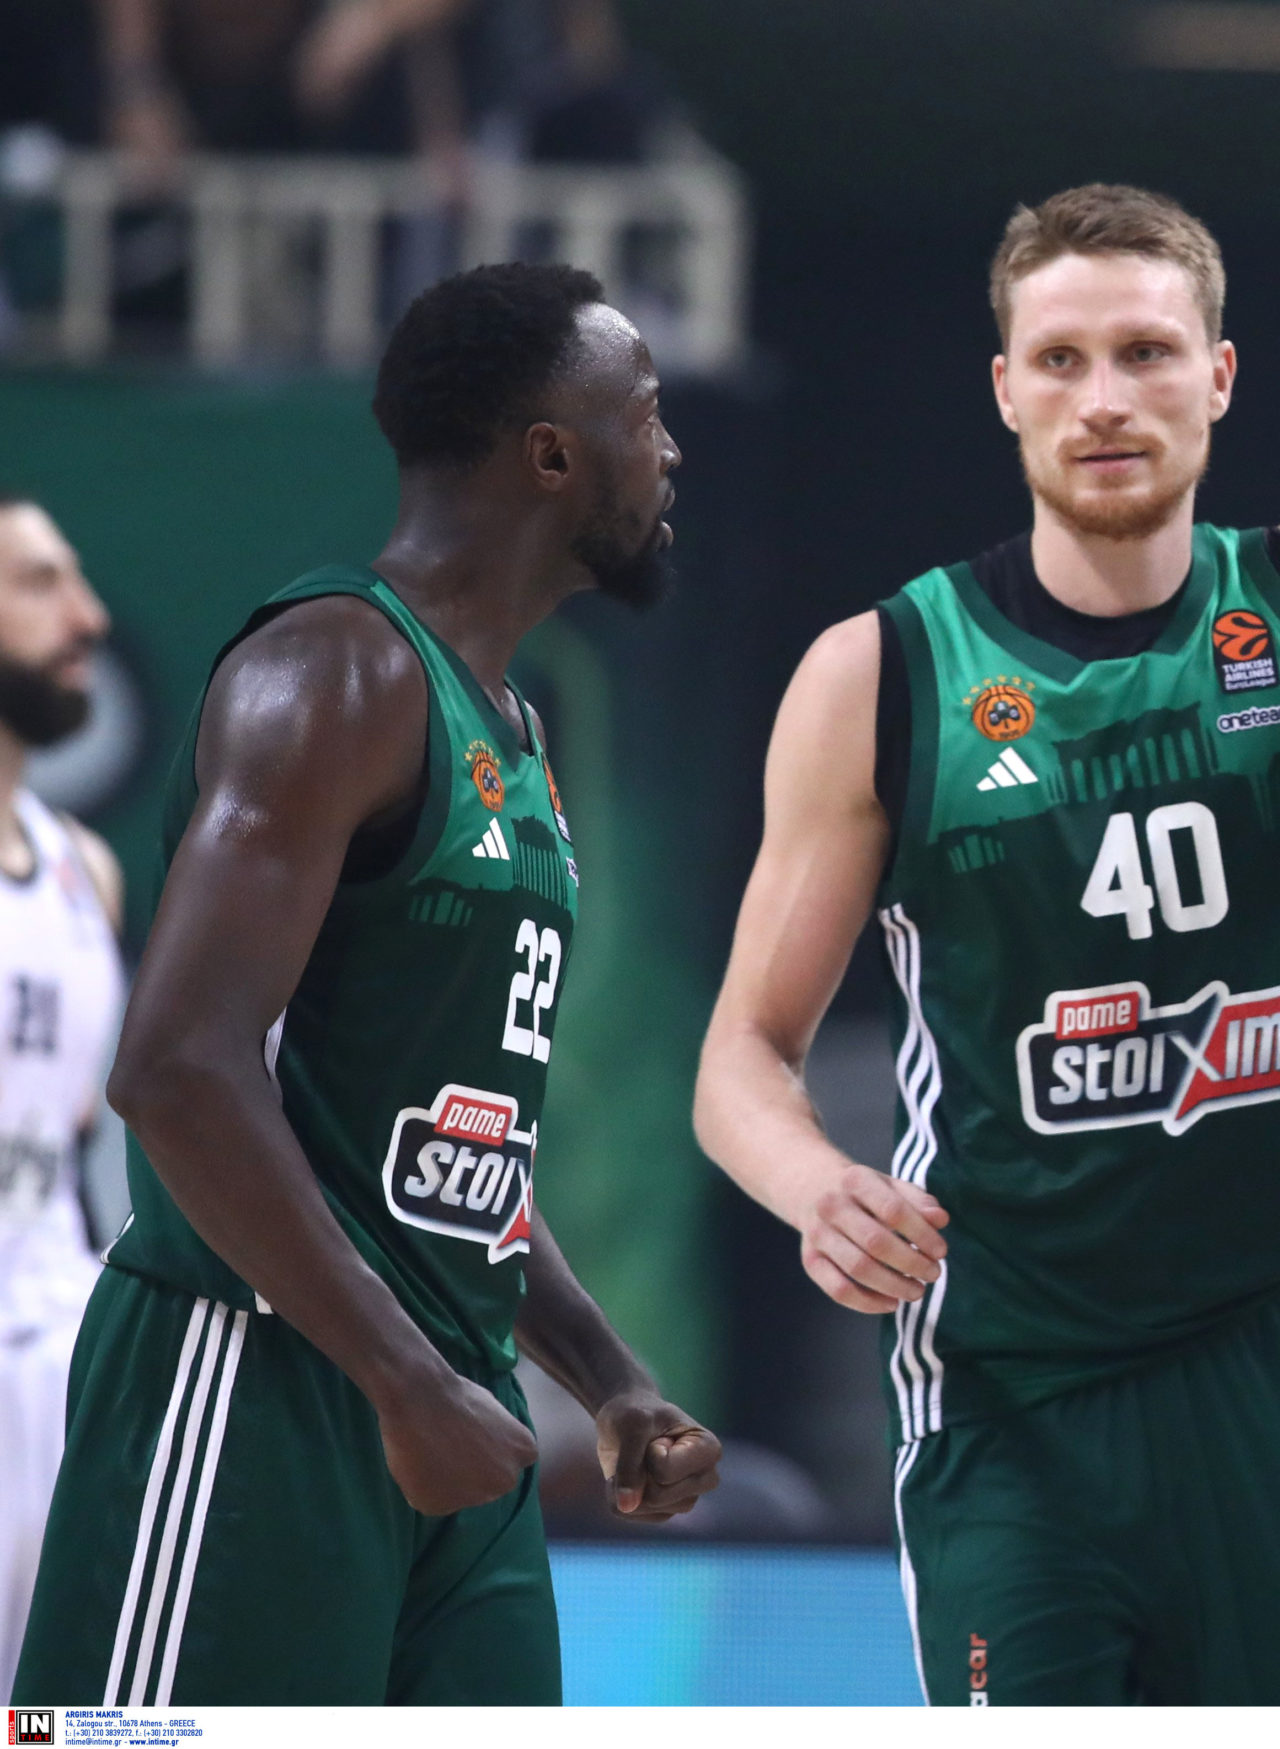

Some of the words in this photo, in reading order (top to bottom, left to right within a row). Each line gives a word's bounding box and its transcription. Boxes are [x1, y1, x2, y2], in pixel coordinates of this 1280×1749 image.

[1222, 658, 1273, 674] TURKISH
[1225, 667, 1275, 683] AIRLINES
[1080, 801, 1230, 941] 40
[501, 918, 562, 1064] 22
[1062, 999, 1132, 1036] pame
[442, 1101, 508, 1139] pame
